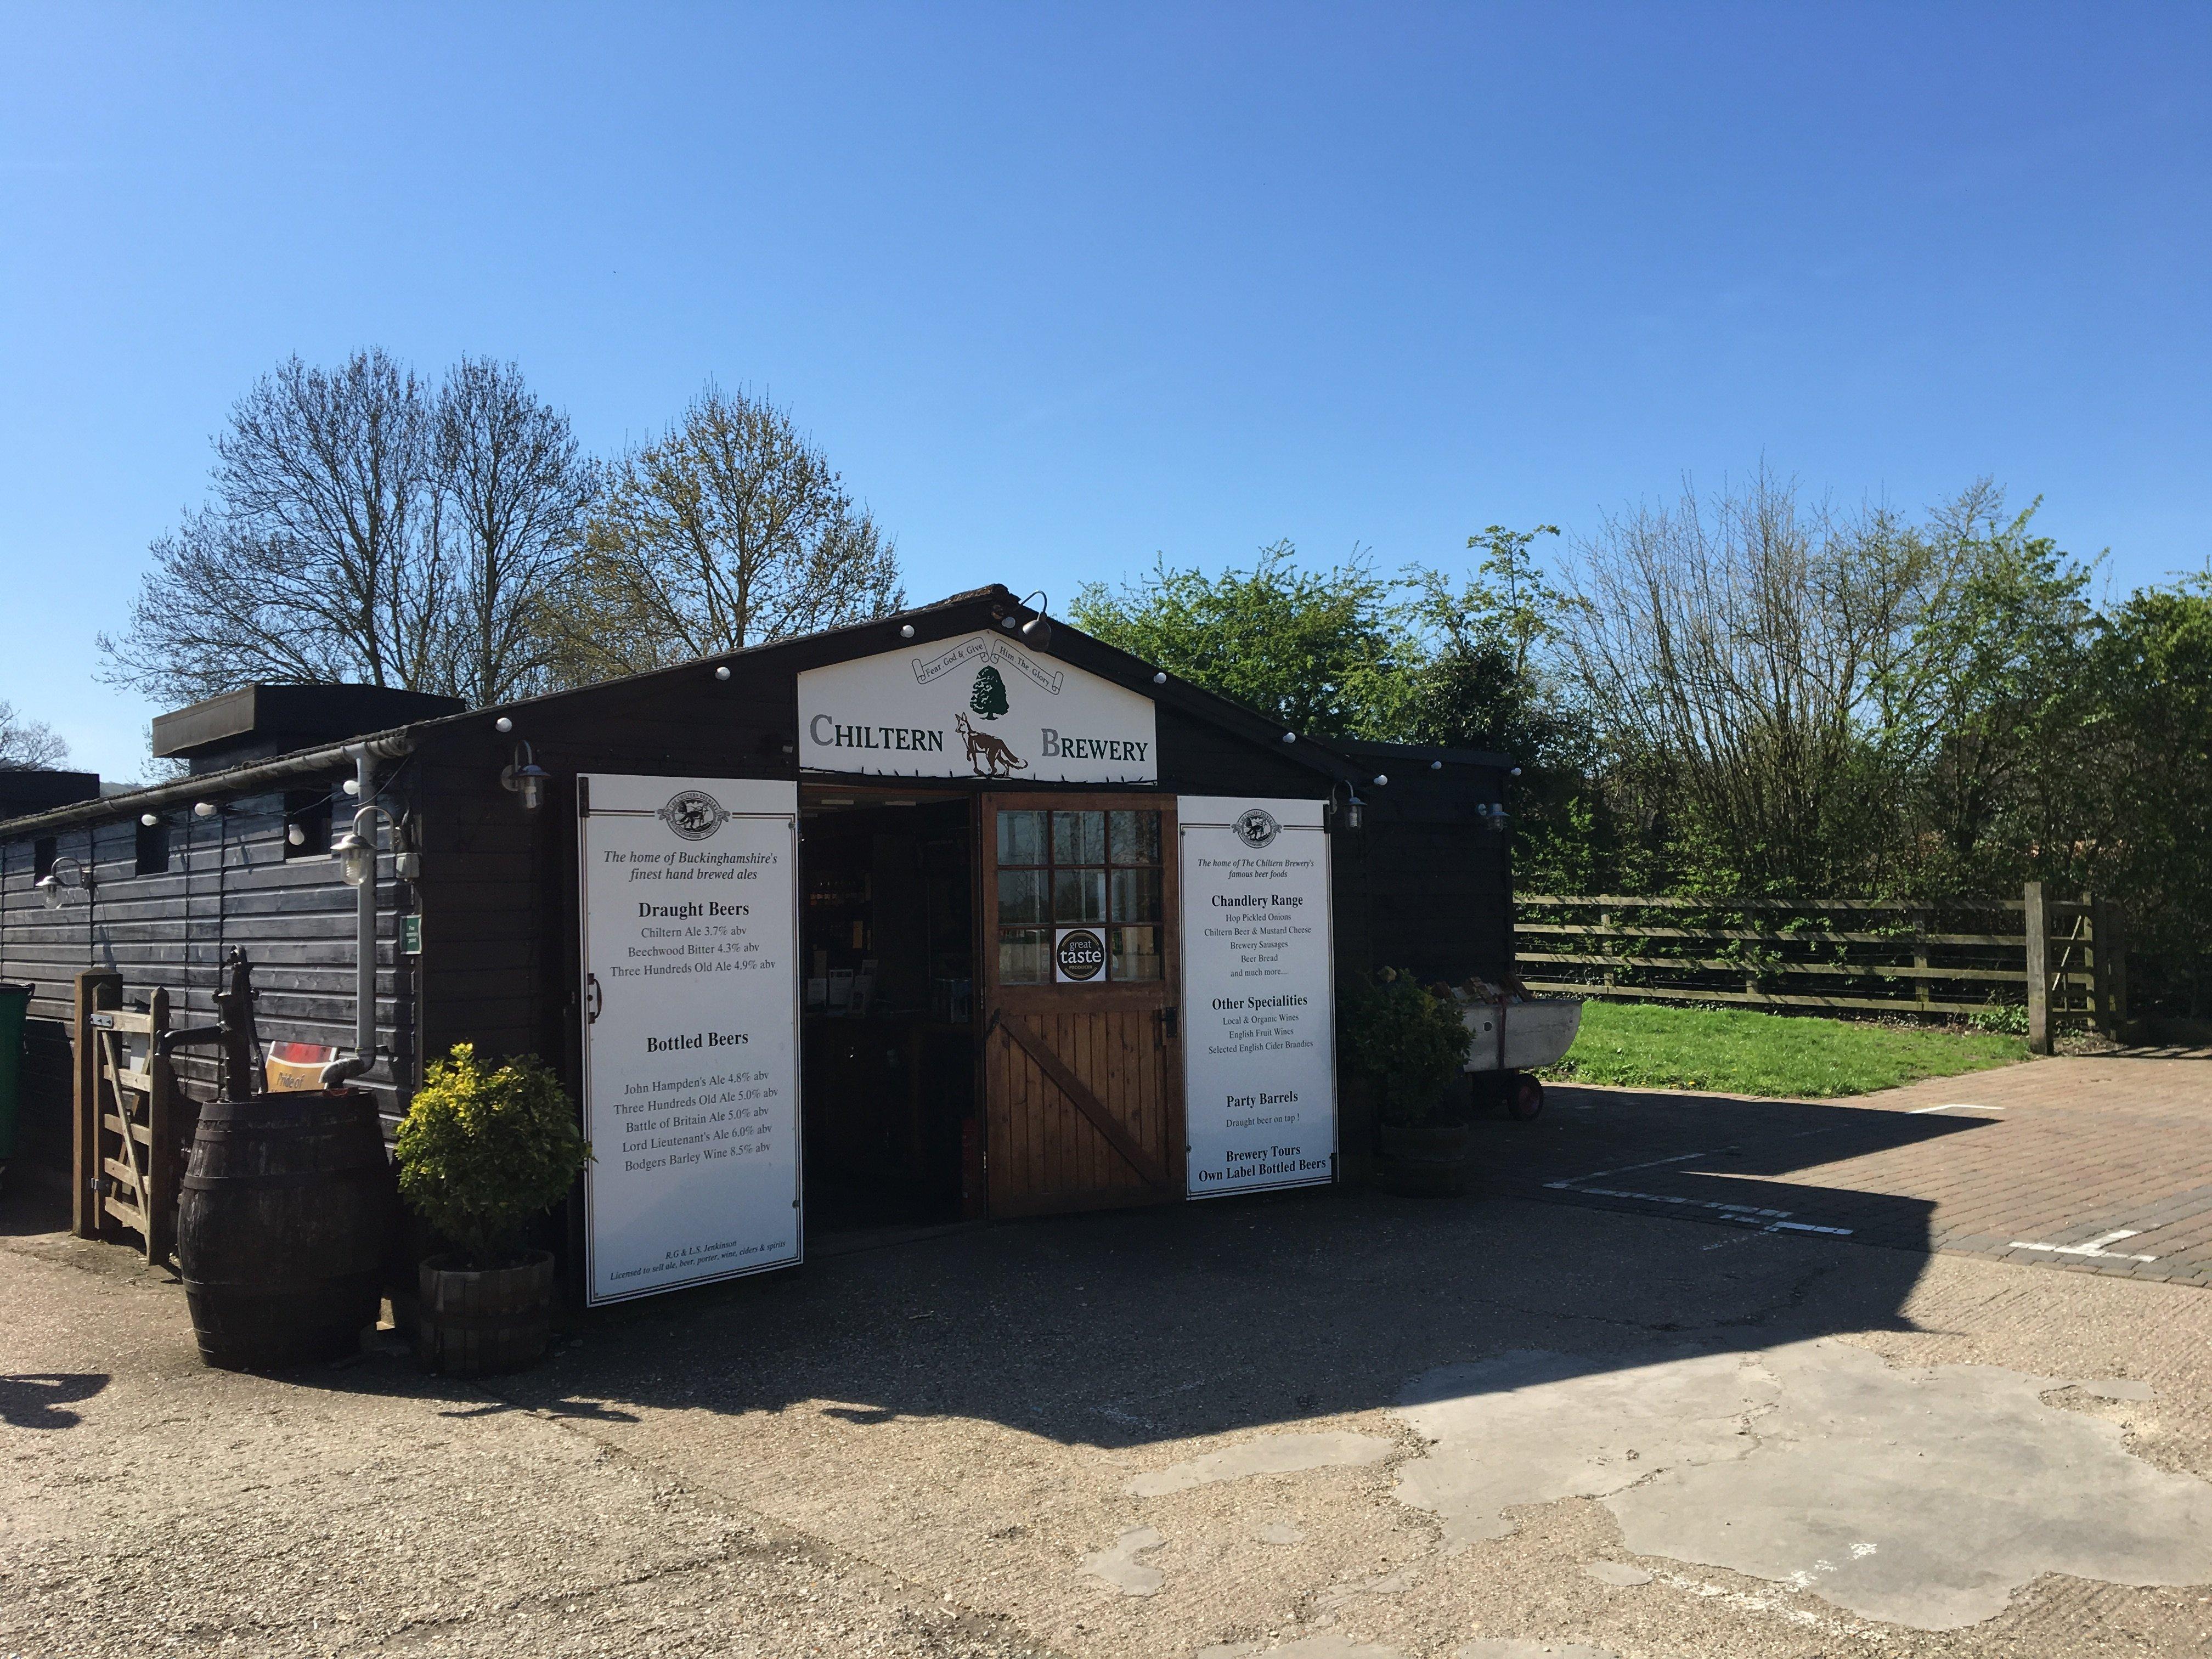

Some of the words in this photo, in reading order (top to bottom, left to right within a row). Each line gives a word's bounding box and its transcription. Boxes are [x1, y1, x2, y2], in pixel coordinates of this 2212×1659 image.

[925, 665, 941, 677] Fear
[943, 653, 957, 666] God
[958, 650, 964, 659] &
[966, 644, 984, 654] Give
[1000, 646, 1014, 661] Him
[1017, 657, 1029, 671] The
[1031, 668, 1049, 687] Glory
[810, 714, 944, 752] CHILTERN
[1041, 728, 1148, 761] BREWERY
[604, 851, 626, 862] The
[629, 851, 661, 862] home
[664, 852, 677, 866] of
[678, 852, 777, 866] Buckinghamshire's
[1198, 859, 1211, 868] The
[1233, 859, 1241, 868] of
[1242, 859, 1255, 867] The
[1285, 860, 1314, 869] Brewery's
[629, 868, 663, 882] finest
[665, 868, 694, 879] hand
[697, 868, 734, 879] brewed
[737, 868, 758, 879] ales
[1228, 870, 1253, 879] famous
[1269, 870, 1288, 879] foods
[1212, 895, 1268, 909] Chandlery
[1271, 894, 1303, 908] Range
[639, 902, 703, 920] Draught
[708, 901, 749, 916] Beers
[1226, 914, 1240, 924] Hop
[1243, 913, 1266, 922] Pickled
[641, 927, 681, 938] Chiltern
[685, 927, 702, 936] Ale
[704, 926, 728, 935] 3.7%
[731, 926, 747, 935] abv
[1204, 927, 1232, 936] Chiltern
[1260, 926, 1286, 934] Mustard
[628, 945, 684, 957] Beechwood
[687, 945, 715, 954] Bitter
[718, 943, 741, 952] 4.3%
[744, 943, 759, 952] abv
[1069, 940, 1092, 951] great
[1231, 942, 1257, 950] Brewery
[1259, 941, 1288, 950] Sausages
[1060, 950, 1102, 963] taste
[610, 967, 640, 977] Three
[644, 963, 692, 975] Hundreds
[695, 962, 712, 972] Old
[715, 962, 731, 971] Ale
[735, 960, 757, 970] 4.9%
[760, 960, 775, 969] abv
[1245, 968, 1262, 976] much
[1212, 997, 1245, 1010] Other
[1246, 994, 1307, 1011] Specialities
[1223, 1016, 1241, 1025] Local
[1251, 1015, 1277, 1025] Organic
[646, 1034, 703, 1052] Bottled
[707, 1032, 748, 1047] Beers
[1229, 1030, 1254, 1040] English
[1256, 1029, 1272, 1037] Fruit
[1209, 1045, 1237, 1054] Selected
[1239, 1043, 1263, 1053] English
[1266, 1042, 1283, 1050] Cider
[1285, 1040, 1313, 1048] Brandies
[276, 1071, 295, 1088] Pride
[295, 1074, 305, 1088] of
[624, 1084, 649, 1094] John
[652, 1077, 706, 1092] Hampden's
[709, 1075, 725, 1085] Ale
[728, 1073, 750, 1083] 4.8%
[754, 1071, 769, 1080] abv
[613, 1103, 644, 1115] Three
[648, 1097, 696, 1111] Hundreds
[699, 1094, 716, 1105] Old
[719, 1092, 736, 1103] Ale
[738, 1088, 760, 1101] 5.0%
[764, 1088, 778, 1097] abv
[1226, 1095, 1256, 1109] Party
[1260, 1091, 1298, 1105] Barrels
[626, 1120, 657, 1133] Battle
[659, 1118, 670, 1128] of
[673, 1114, 706, 1127] Britain
[709, 1111, 725, 1122] Ale
[728, 1109, 751, 1120] 5.0%
[754, 1107, 769, 1116] abv
[1226, 1118, 1255, 1128] Draught
[1284, 1115, 1295, 1124] tap
[623, 1139, 647, 1152] Lord
[651, 1132, 710, 1149] Lieutenant's
[713, 1130, 729, 1140] Ale
[732, 1126, 754, 1137] 6.0%
[757, 1124, 772, 1134] abv
[625, 1158, 666, 1171] Bodgers
[669, 1153, 701, 1165] Barley
[703, 1149, 727, 1159] Wine
[731, 1144, 753, 1156] 8.5%
[756, 1143, 770, 1153] abv
[1226, 1150, 1268, 1162] Brewery
[1271, 1146, 1300, 1157] Tours
[1199, 1170, 1222, 1182] Own
[1226, 1165, 1255, 1180] Label
[1259, 1160, 1295, 1176] Bottled
[1299, 1159, 1326, 1170] Beers
[703, 1240, 737, 1252] Jenkinson
[610, 1268, 641, 1280] Licensed
[652, 1263, 664, 1272] sell
[665, 1261, 677, 1271] ale,
[680, 1259, 695, 1267] beer,
[696, 1255, 719, 1265] porter,
[721, 1250, 738, 1259] wine,
[739, 1247, 758, 1256] ciders
[767, 1240, 786, 1251] spirits
